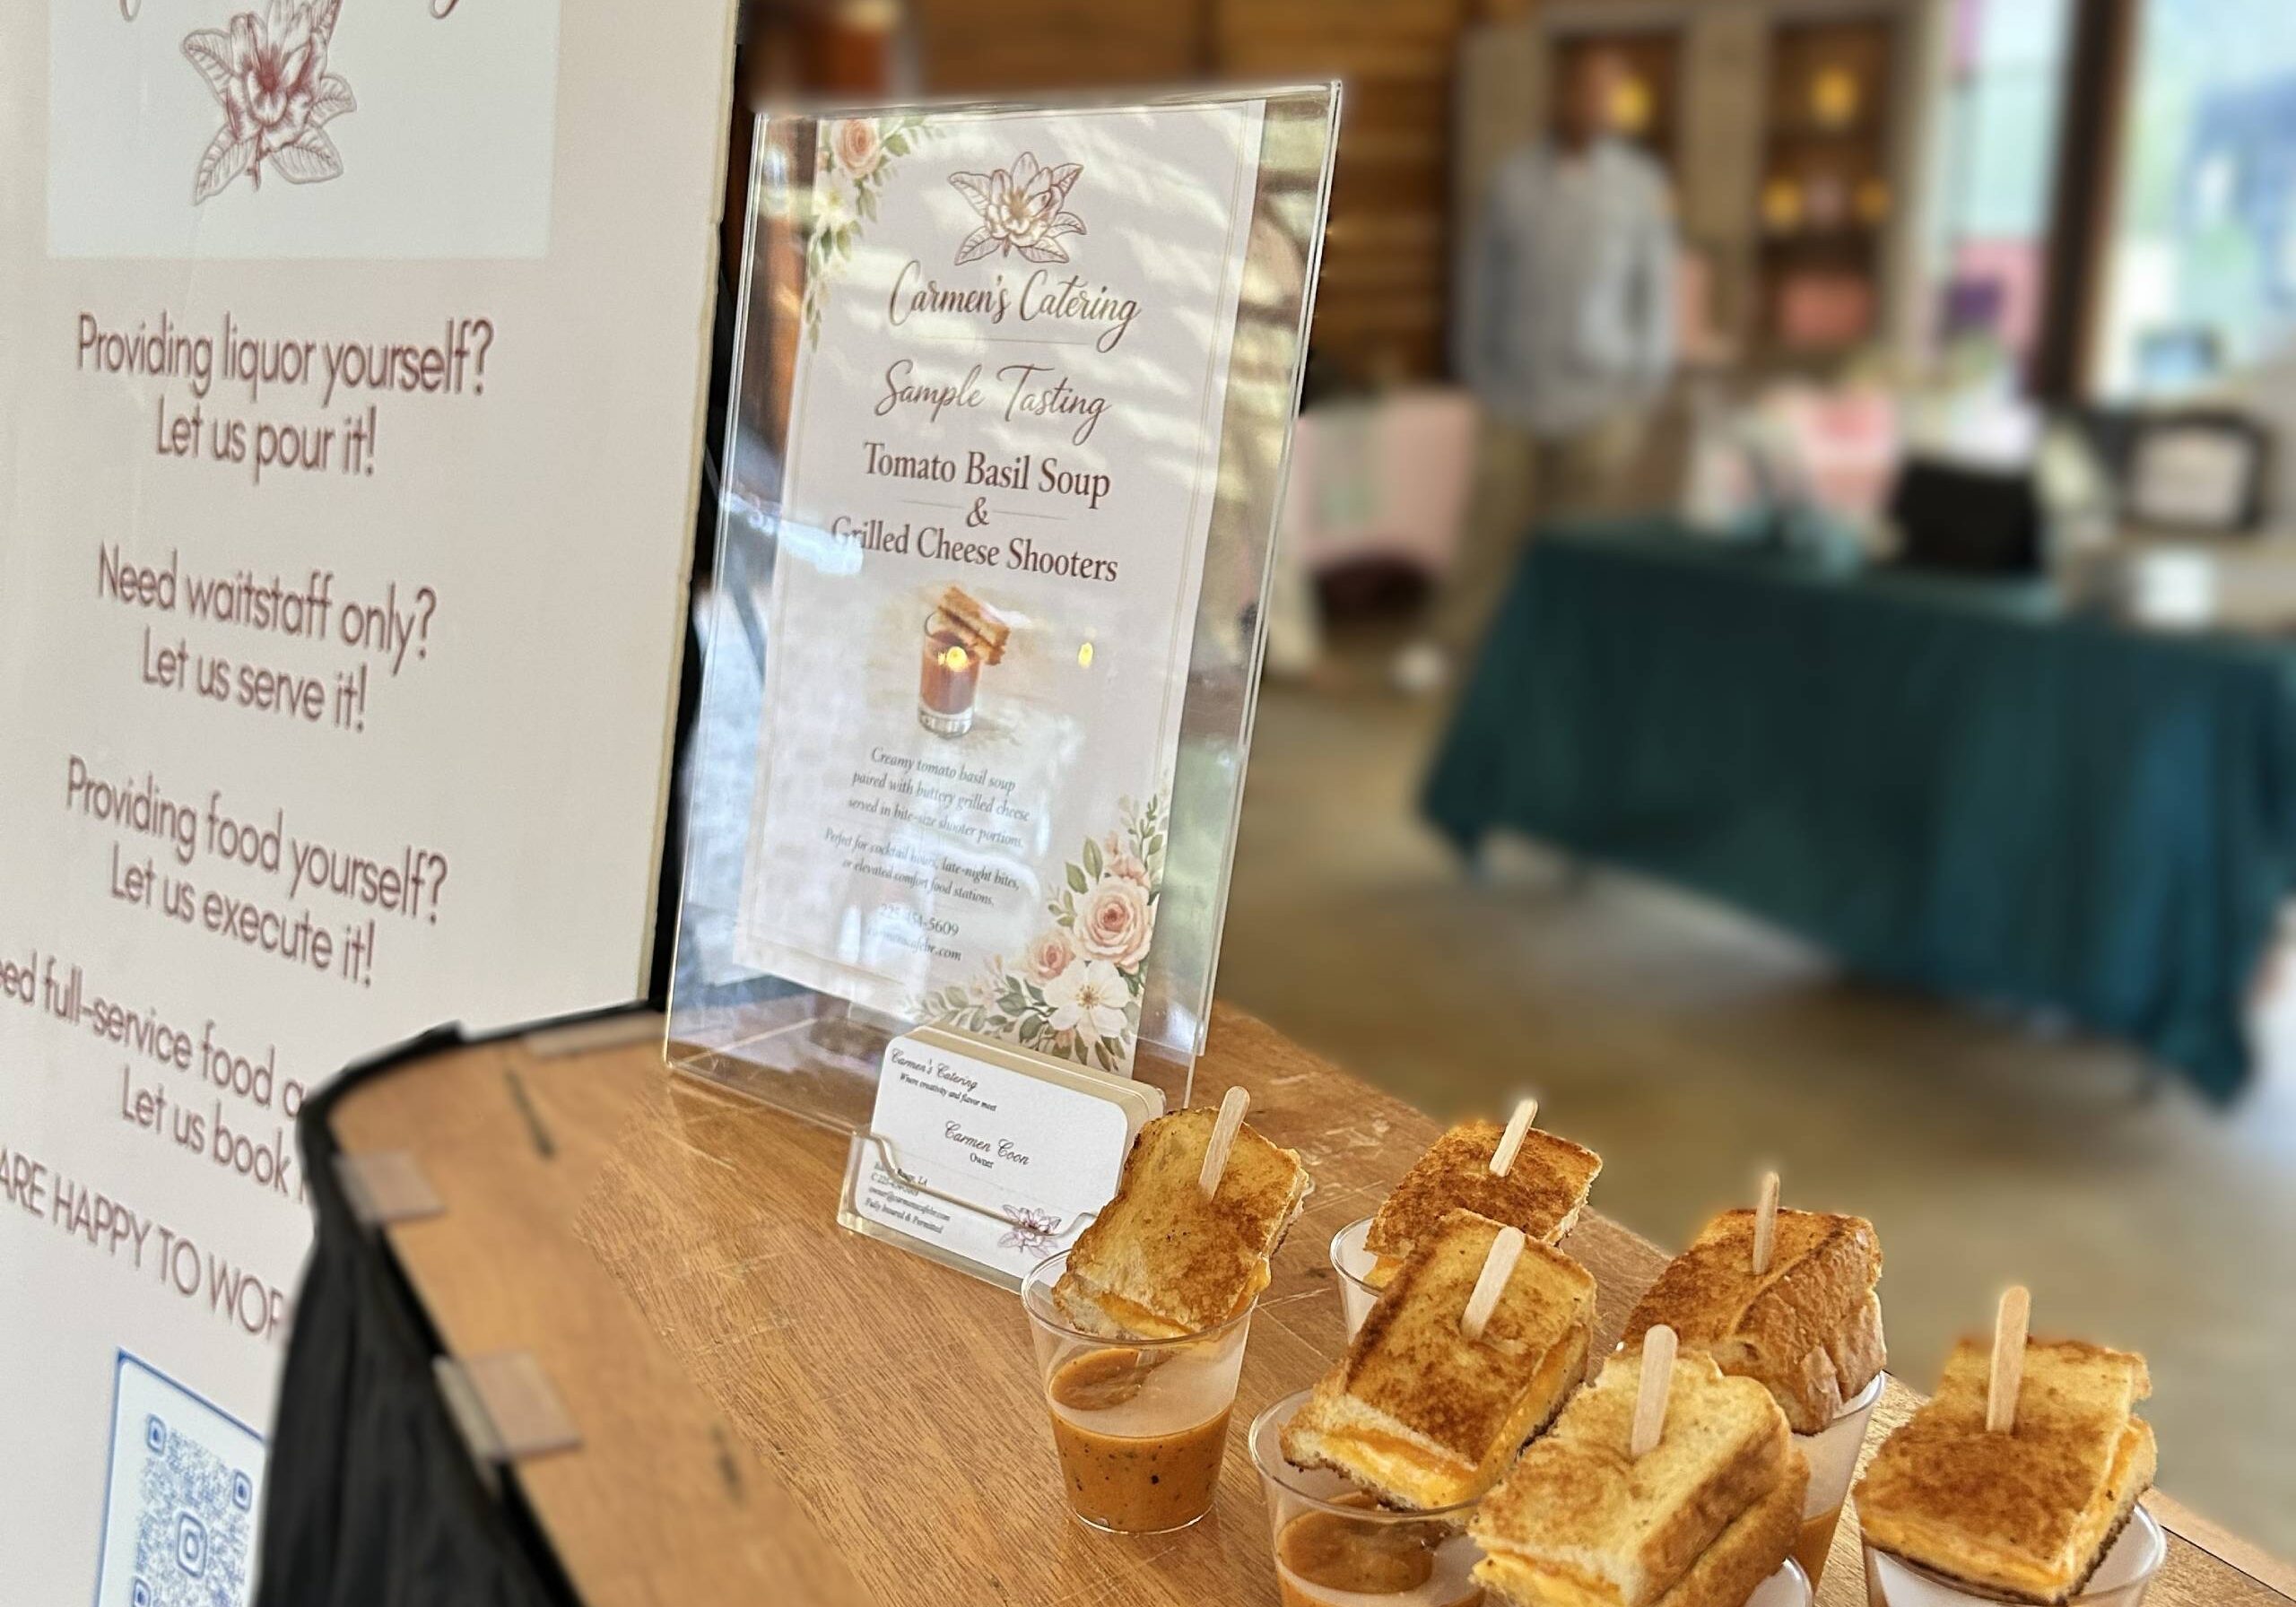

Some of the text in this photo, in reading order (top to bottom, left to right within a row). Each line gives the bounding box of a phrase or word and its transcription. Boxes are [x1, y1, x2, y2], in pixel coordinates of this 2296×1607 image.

[890, 259, 1144, 353] Carmen's Catering
[77, 310, 494, 408] Providing liquor yourself?
[156, 395, 377, 485] Let us pour it!
[874, 359, 1112, 446] Sample Tasting
[864, 442, 1111, 509] Tomato Basil Soup
[966, 497, 990, 527] &
[831, 516, 1119, 583] Grilled Cheese Shooters
[99, 542, 438, 676] Need waitstaff only?
[142, 627, 369, 734] Let us serve it!
[848, 797, 879, 813] served
[881, 803, 891, 816] in
[852, 770, 1031, 821] paired with buttery grilled cheese
[872, 746, 1016, 796] Creamy tomato basil soup
[66, 754, 448, 925] Providing food yourself?
[943, 856, 992, 885] late-night
[994, 869, 1020, 890] bites,
[111, 841, 375, 987] Let us execute it!
[927, 878, 952, 894] food
[43, 954, 193, 1071] full-service
[201, 1019, 276, 1107] food
[891, 1047, 978, 1092] Carmen's Catering
[122, 1064, 166, 1134] Let
[173, 1104, 206, 1154] us
[213, 1099, 291, 1197] book
[944, 1120, 1031, 1166] Carmen Coon
[970, 1152, 995, 1169] Owner
[53, 1172, 152, 1269] HAPPY
[158, 1225, 201, 1296] TO
